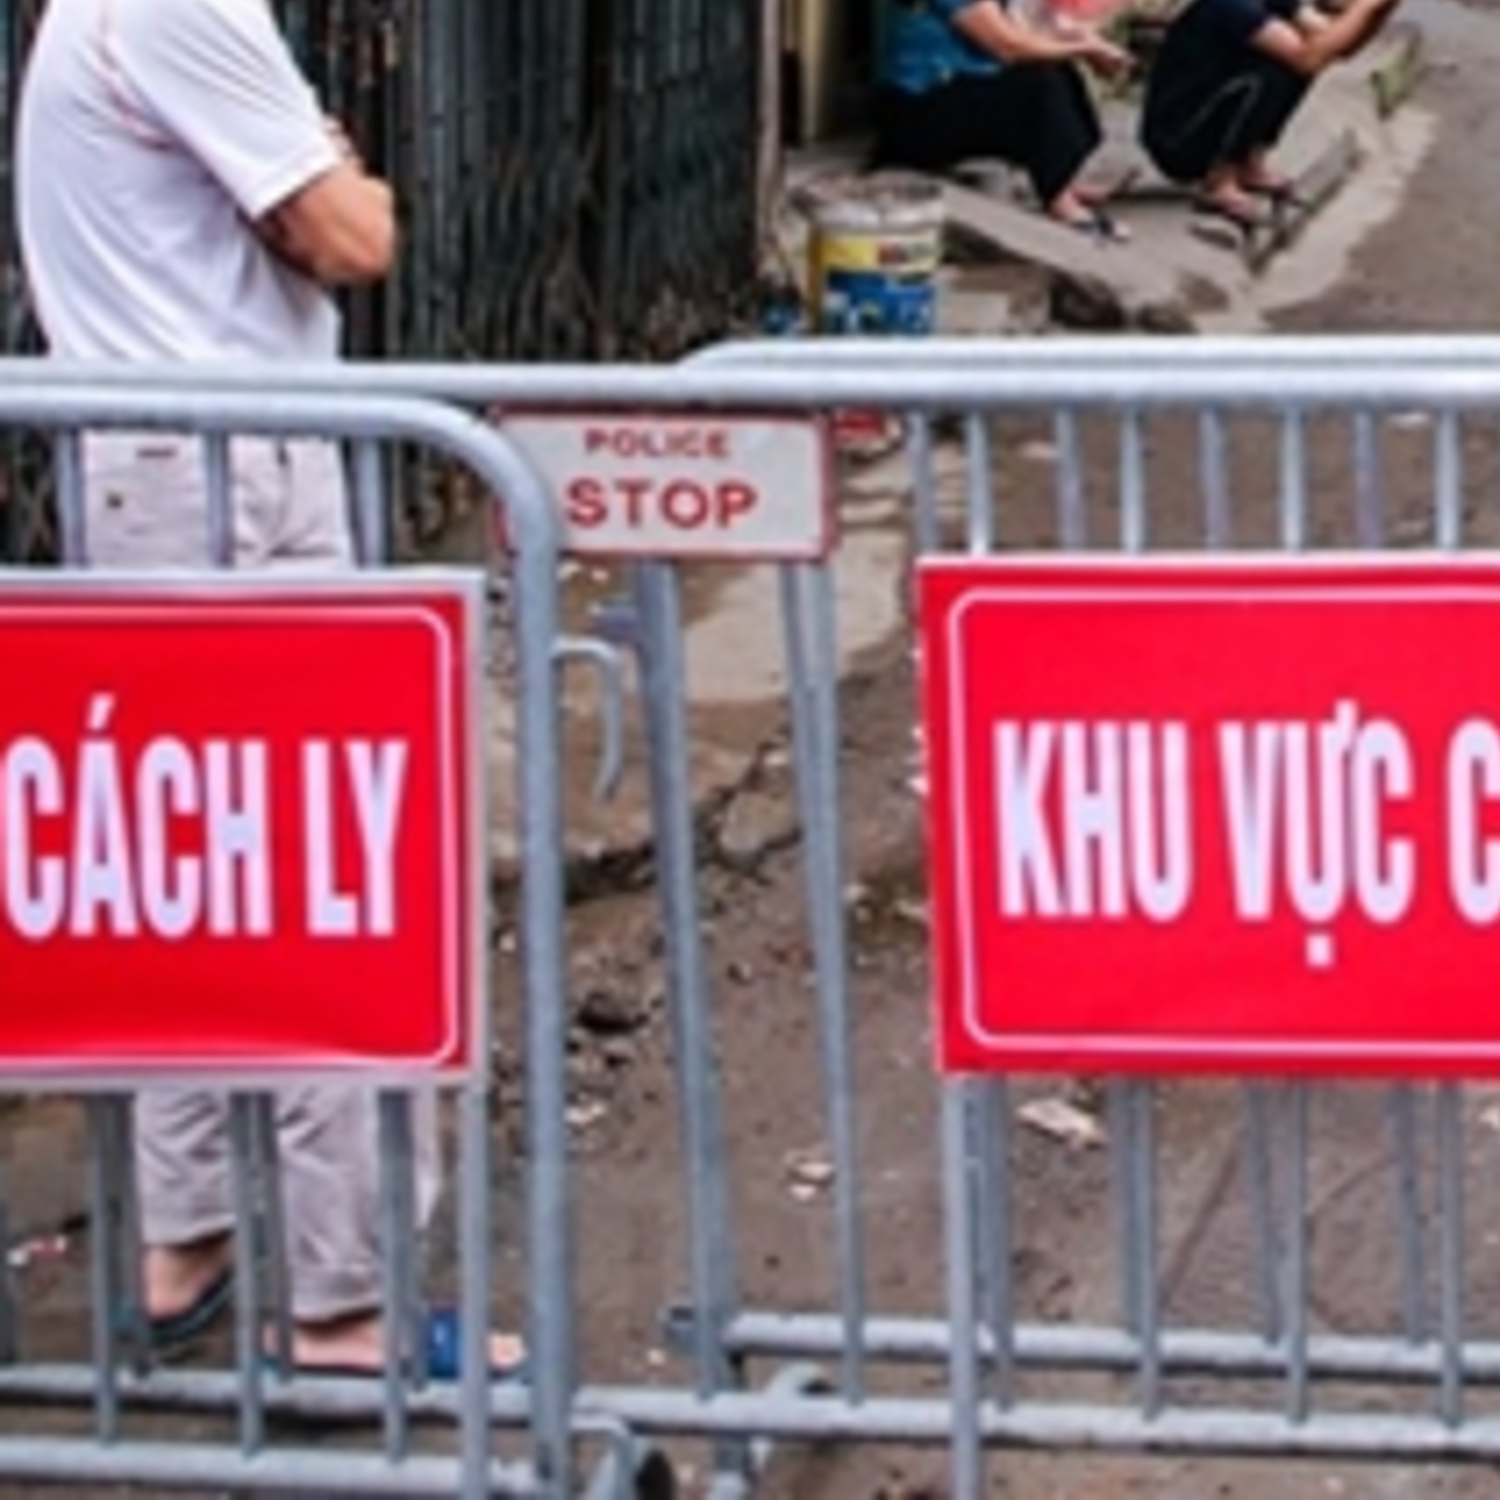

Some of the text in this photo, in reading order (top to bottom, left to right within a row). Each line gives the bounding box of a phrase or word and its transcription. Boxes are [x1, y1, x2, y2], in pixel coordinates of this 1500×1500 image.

[566, 479, 758, 527] STOP
[584, 428, 731, 459] POLICE
[0, 694, 408, 940] CÁCH LY
[995, 718, 1192, 923] KHU
[1218, 698, 1415, 967] VỰC
